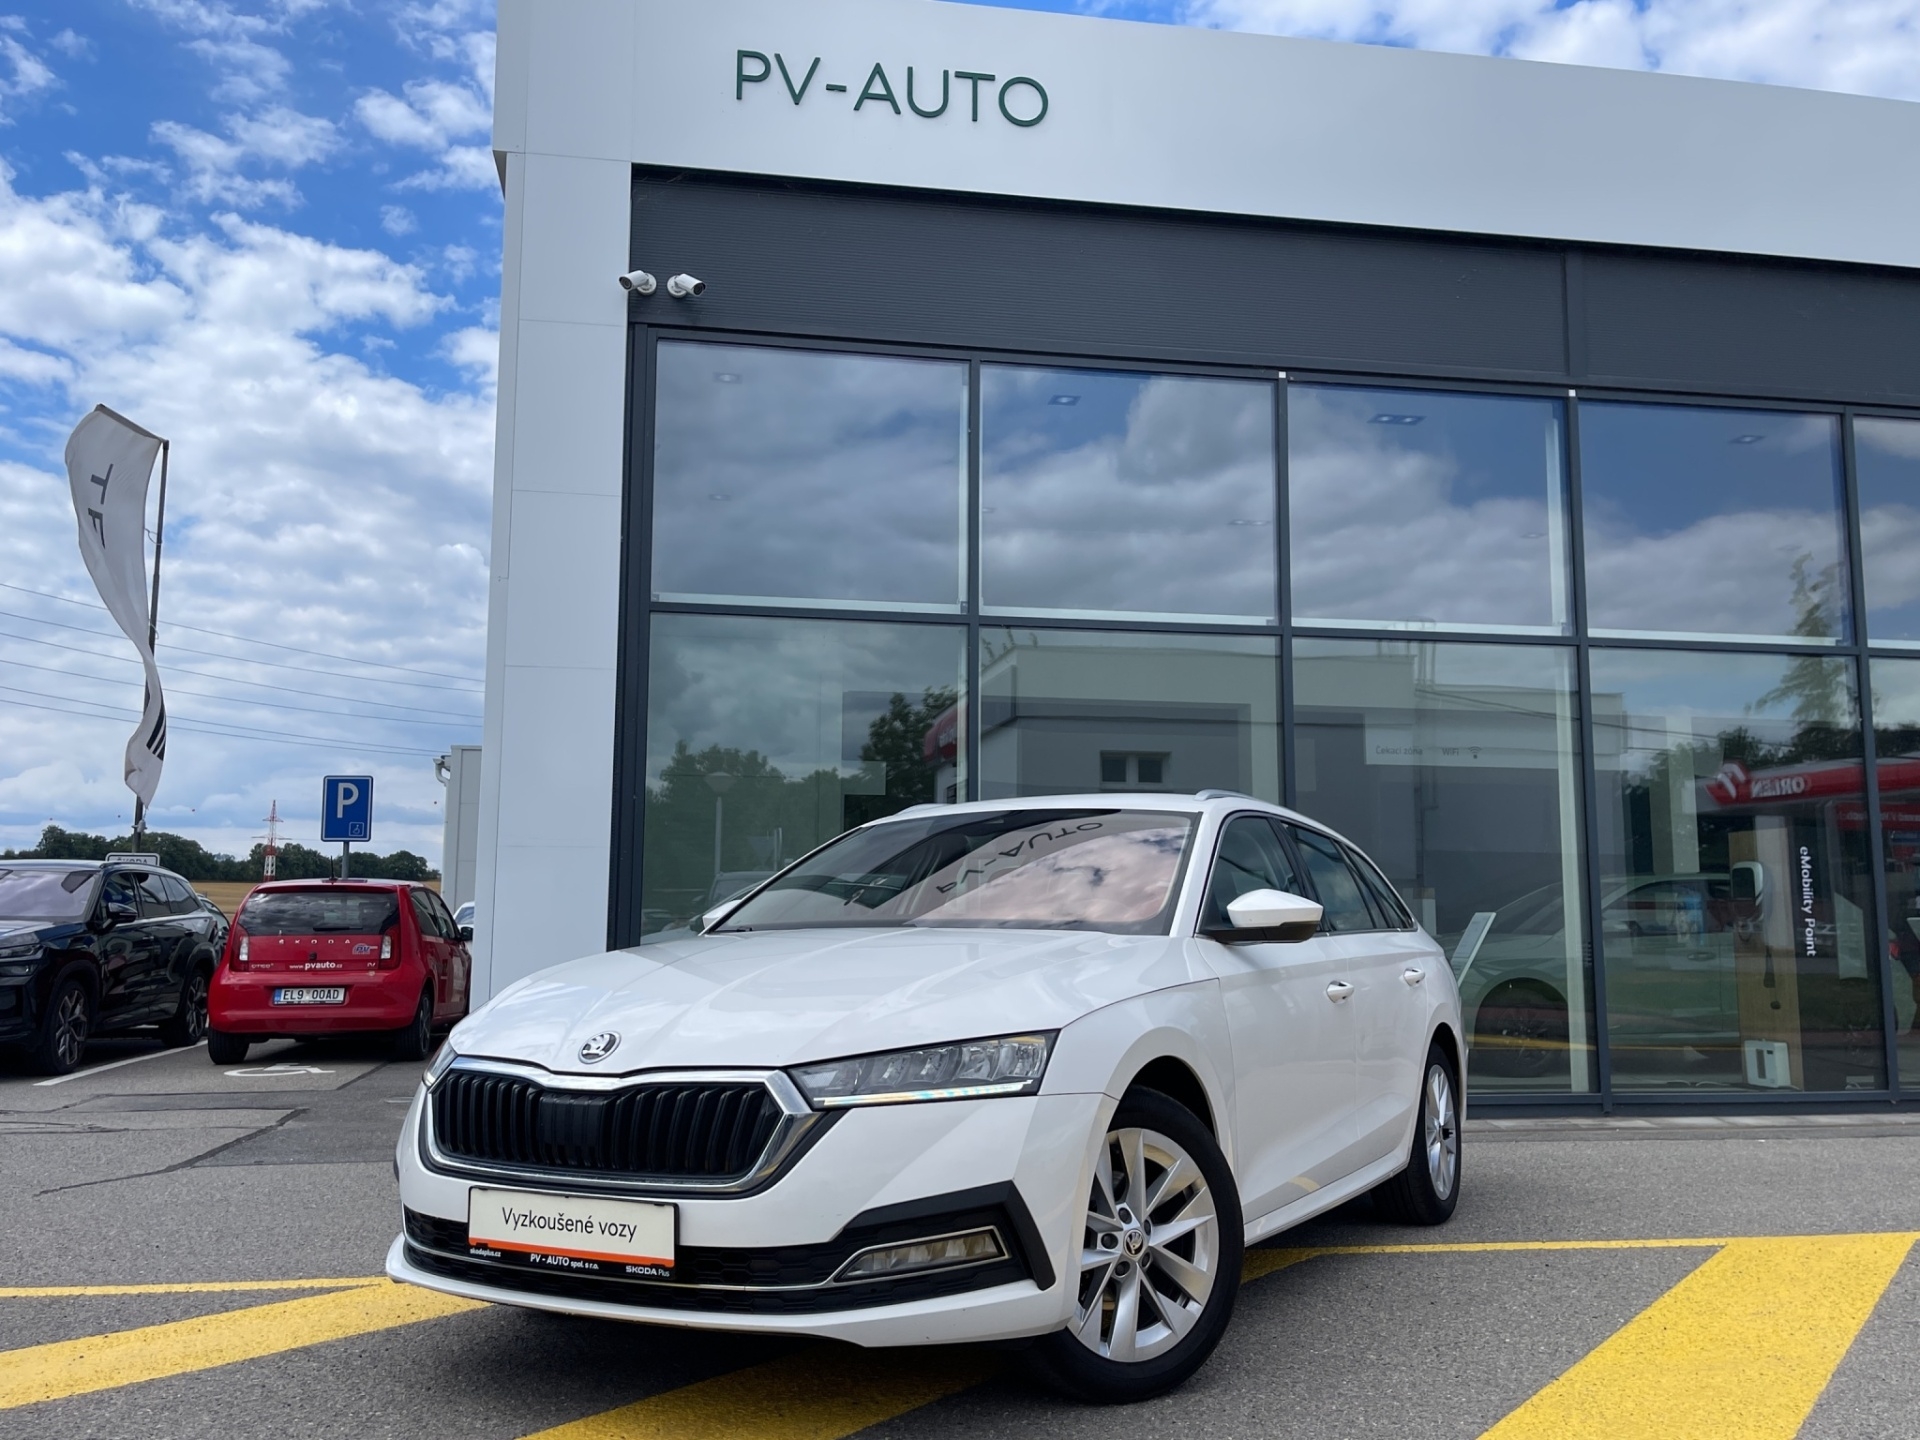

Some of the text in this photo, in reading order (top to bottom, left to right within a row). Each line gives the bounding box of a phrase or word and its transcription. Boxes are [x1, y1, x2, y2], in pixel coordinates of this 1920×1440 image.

[736, 49, 1049, 128] PV-AUTO
[337, 782, 359, 819] P
[1799, 846, 1817, 957] eMobility Point
[283, 989, 304, 1000] EL9
[502, 1206, 637, 1243] Vyzkoušené vozy
[546, 1255, 570, 1267] AUTO
[658, 1268, 670, 1278] Plus
